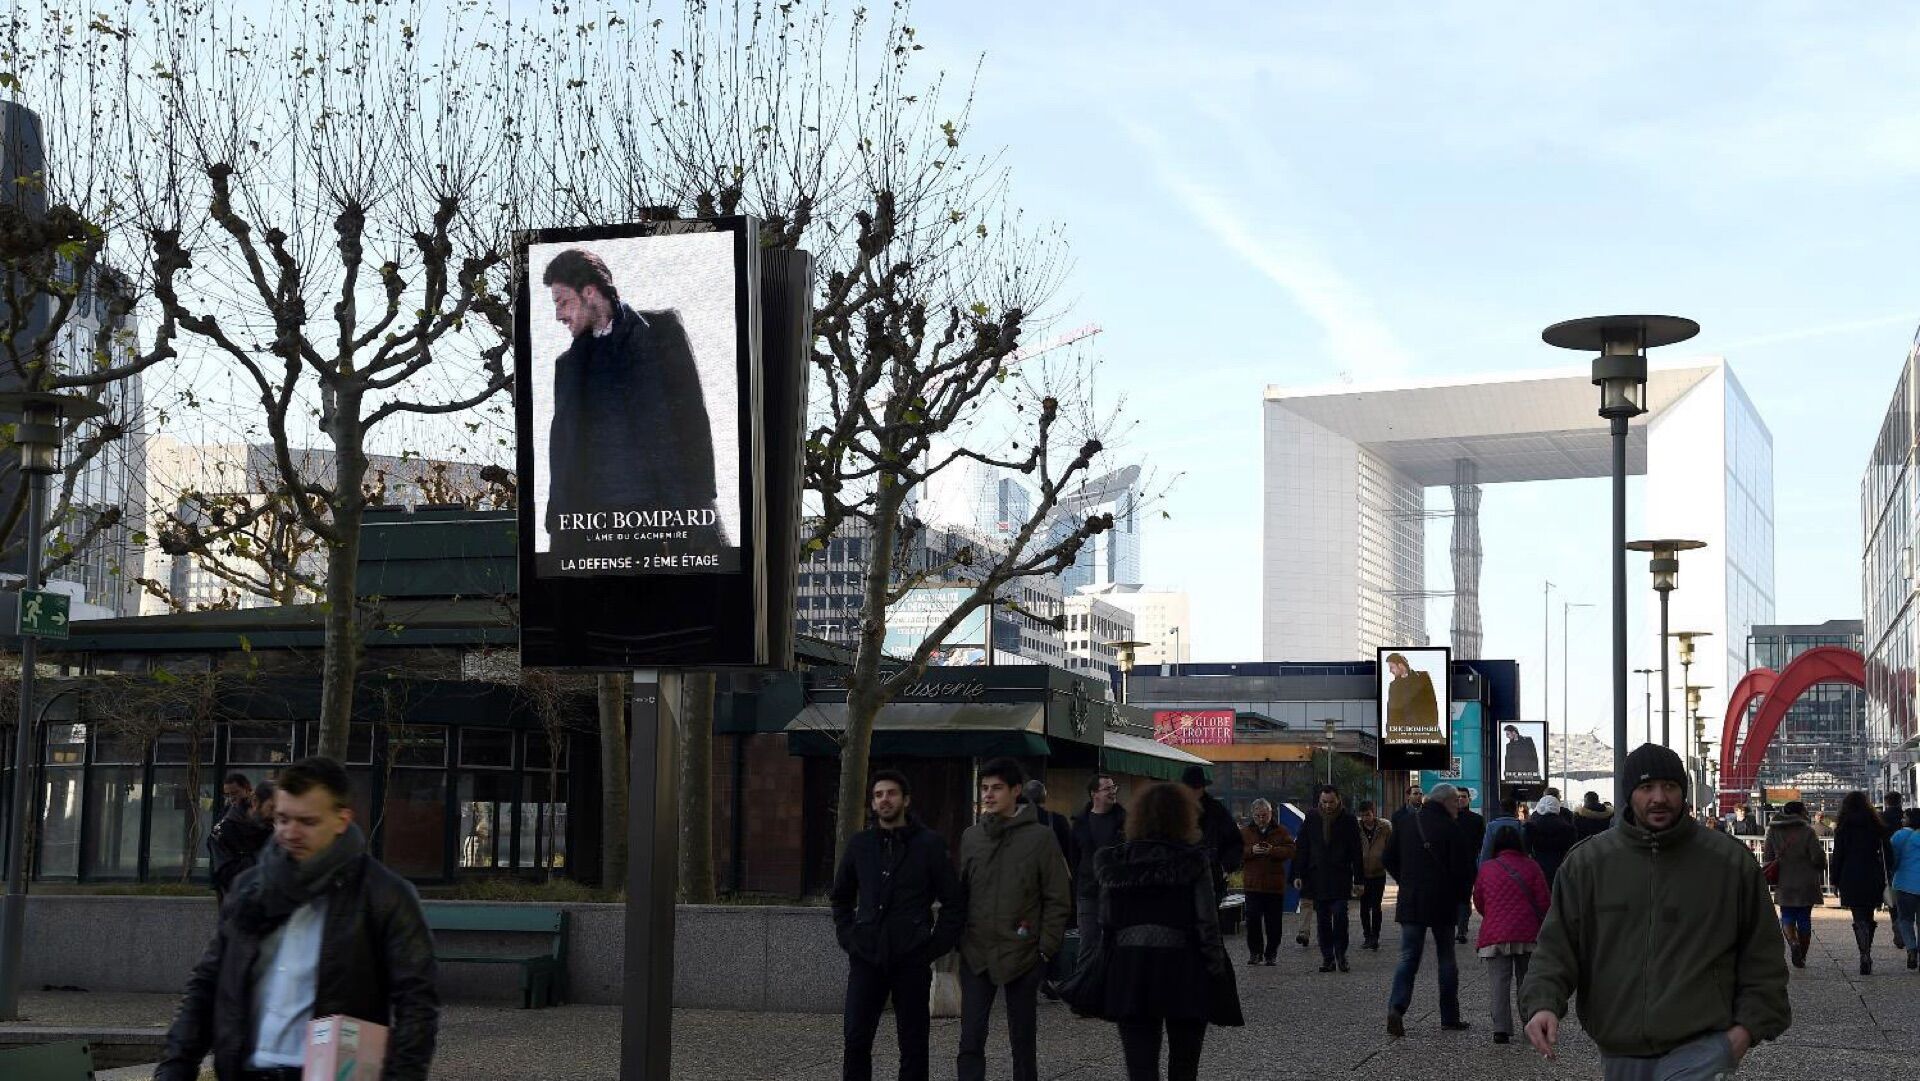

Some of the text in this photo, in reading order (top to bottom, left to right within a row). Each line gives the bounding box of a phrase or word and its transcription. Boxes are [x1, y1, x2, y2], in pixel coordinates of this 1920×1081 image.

[558, 509, 717, 531] ERIC BOMPARD
[617, 532, 630, 541] DU
[633, 531, 688, 541] CACHEMIRE
[561, 559, 576, 571] LA
[578, 556, 633, 571] DEFENSE
[643, 556, 650, 568] 2
[1195, 716, 1231, 727] GLOBE
[1181, 727, 1231, 738] TROTTER
